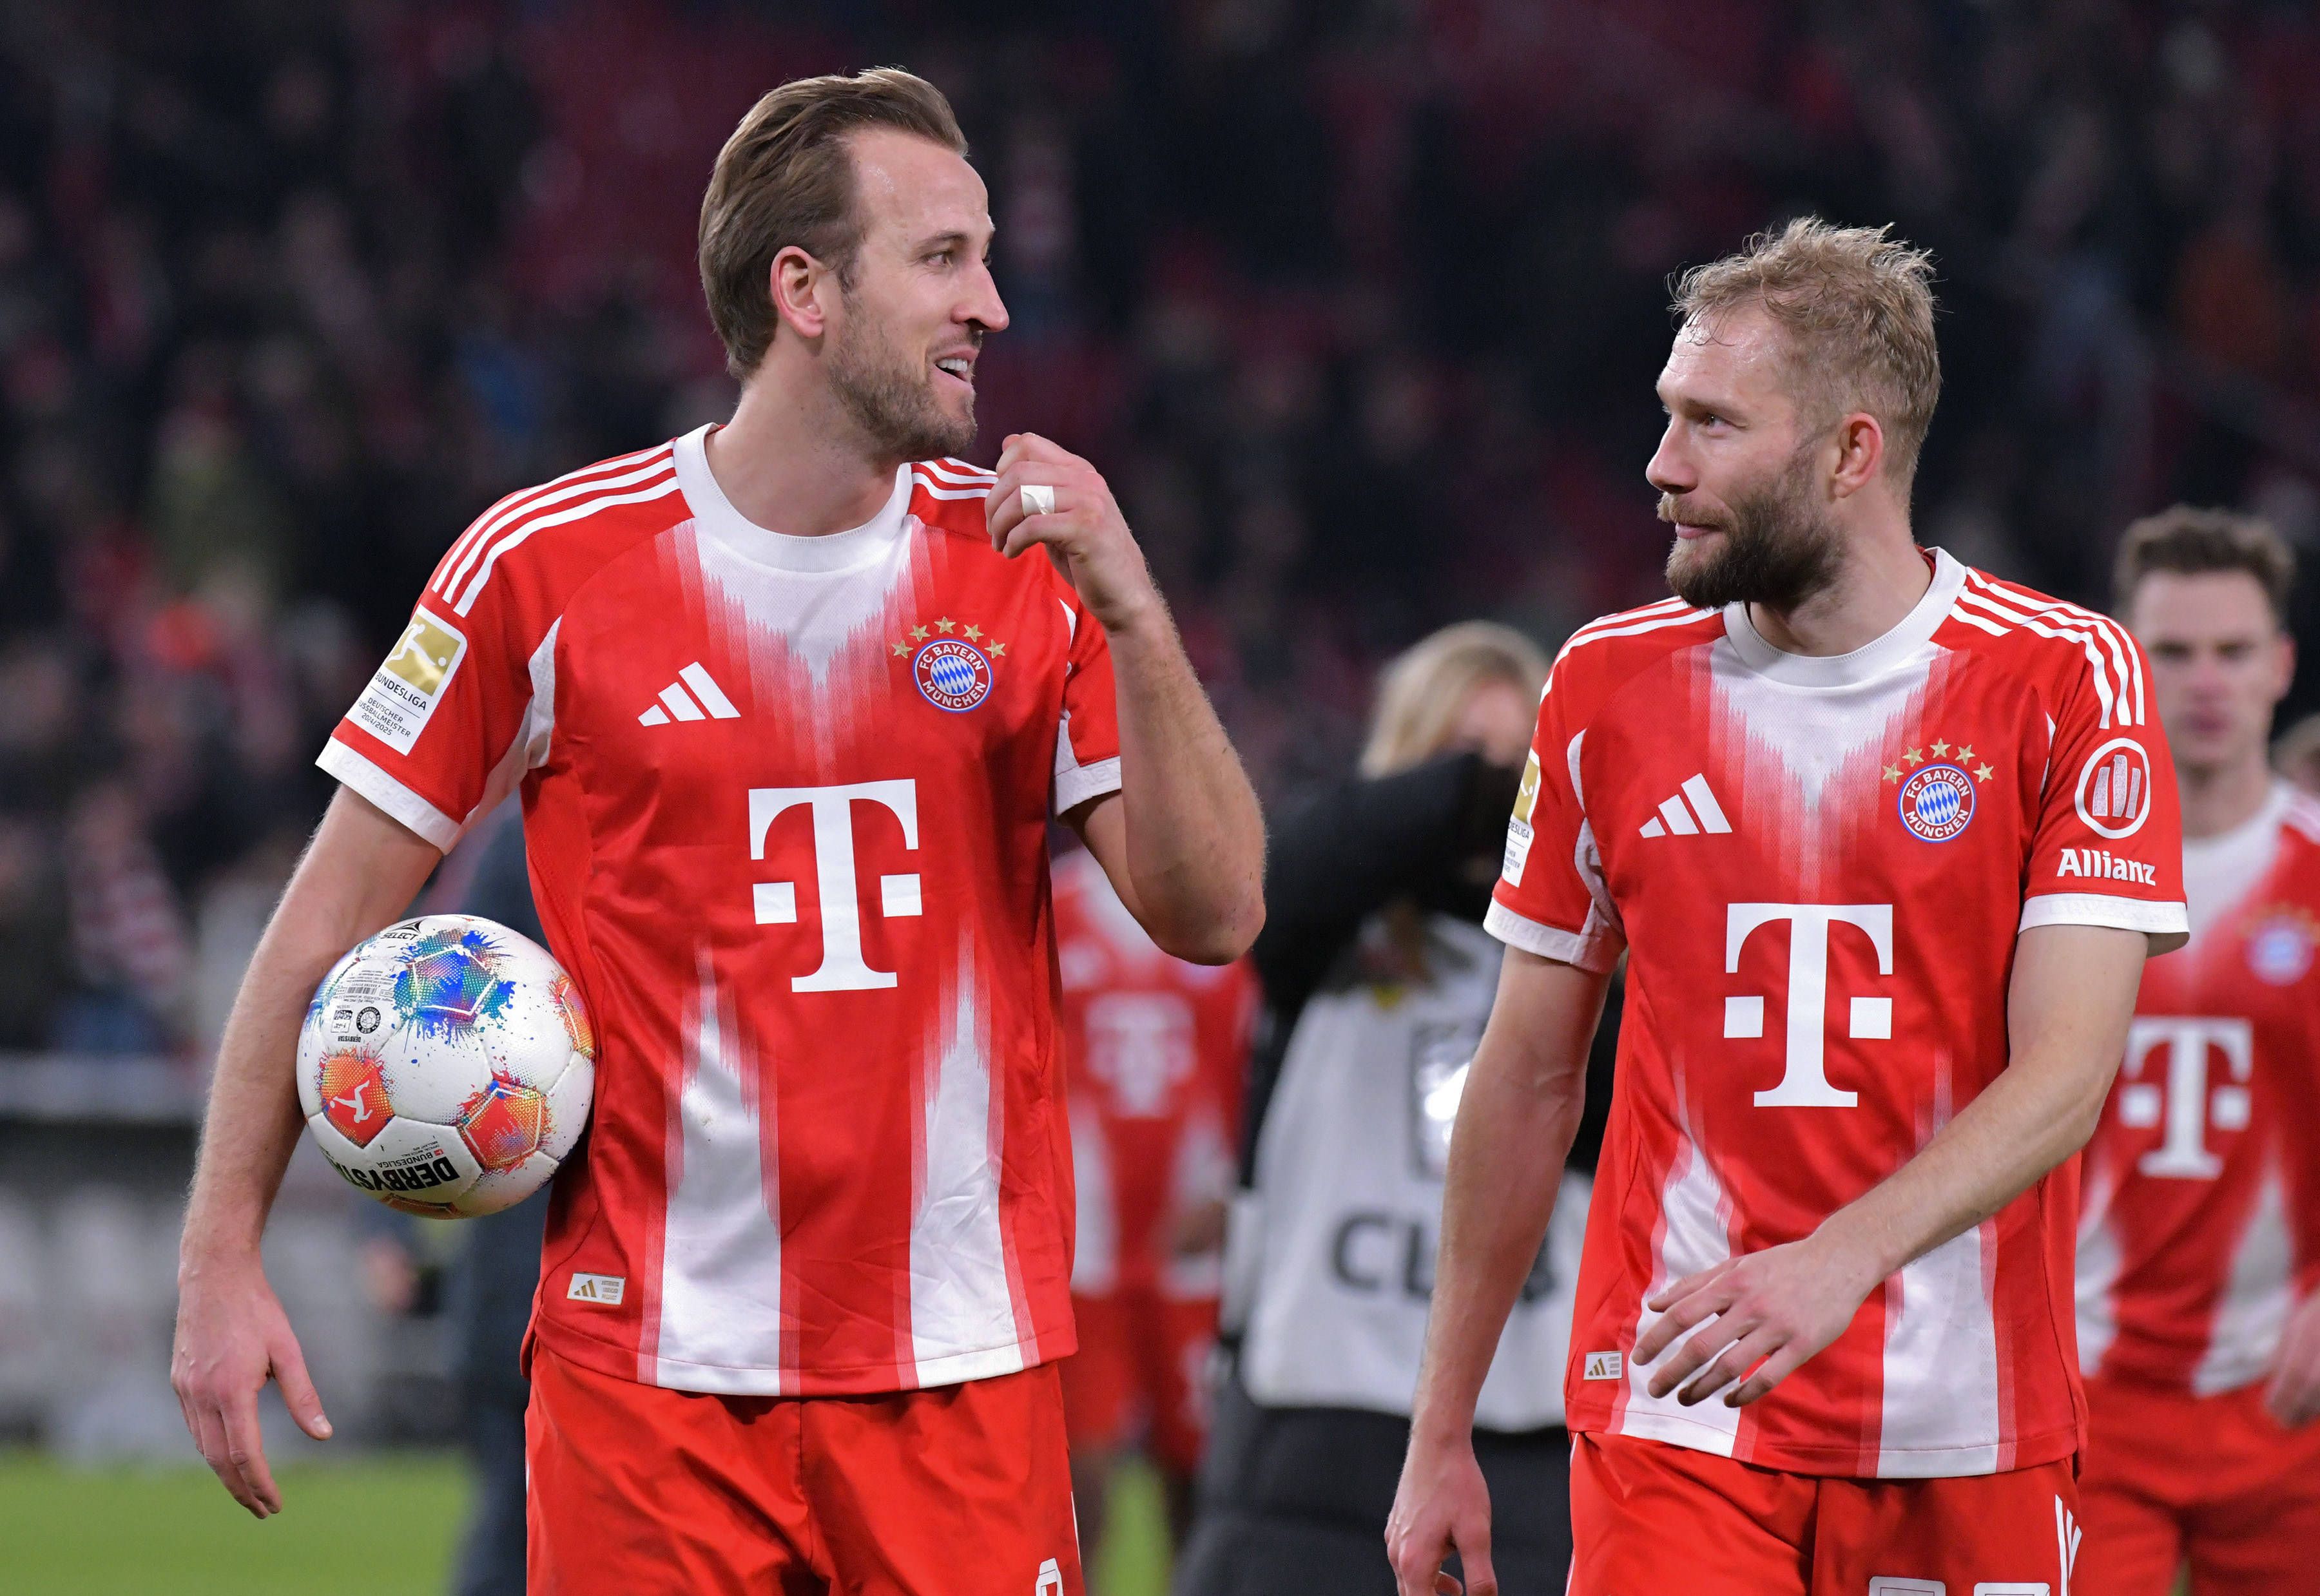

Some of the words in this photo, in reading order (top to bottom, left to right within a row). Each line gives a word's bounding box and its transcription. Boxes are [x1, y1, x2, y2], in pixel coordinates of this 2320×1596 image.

[919, 654, 933, 669] FC
[932, 644, 984, 671] BAYERN
[922, 680, 987, 707] MÜNCHEN
[367, 697, 403, 724] DEUTSCHER
[362, 714, 392, 736] 2024/2025
[1906, 781, 1922, 798] FC
[1922, 770, 1969, 797] BAYERN
[1508, 822, 1529, 839] DESLIGA
[1906, 809, 1969, 838] MÜNCHEN
[2056, 849, 2156, 887] Allianz
[749, 778, 922, 992] T
[1724, 903, 1893, 1107] T
[2120, 1015, 2254, 1180] T
[376, 1152, 433, 1168] BUNDESLIGA
